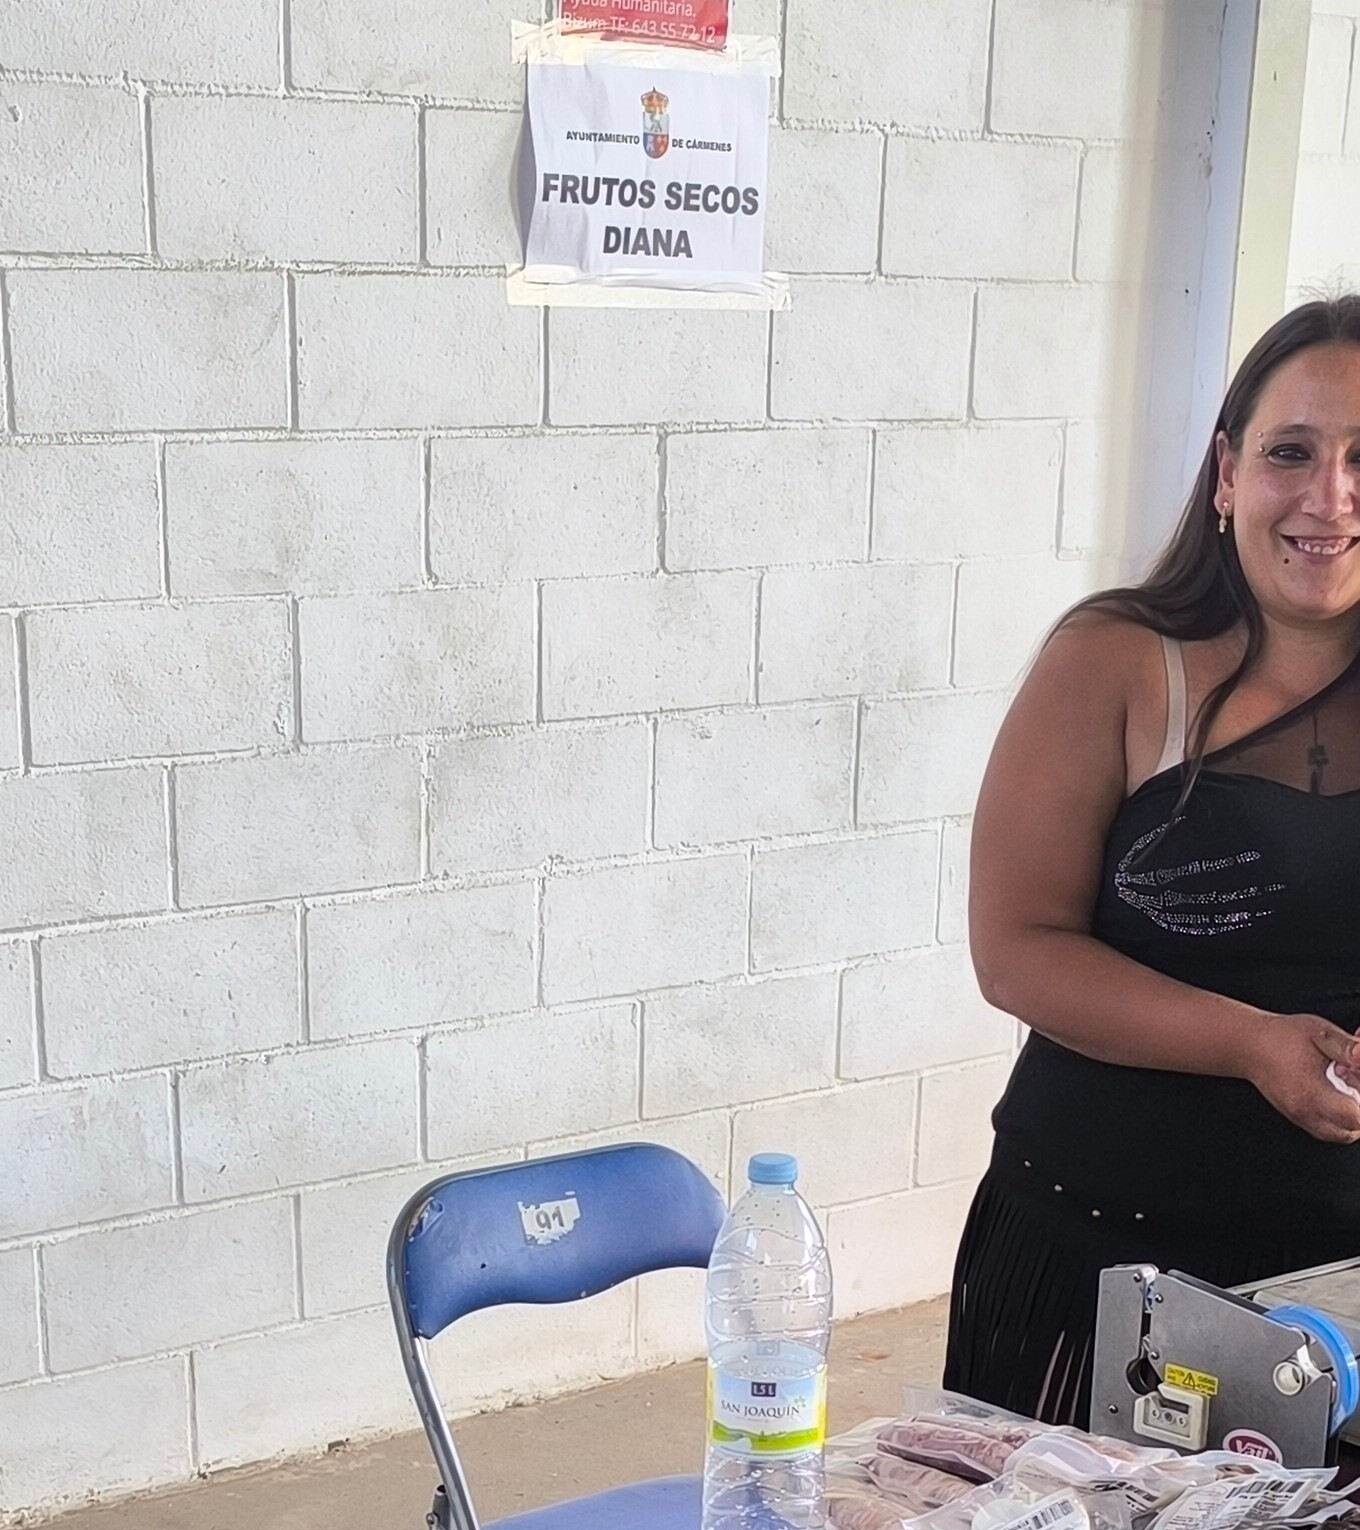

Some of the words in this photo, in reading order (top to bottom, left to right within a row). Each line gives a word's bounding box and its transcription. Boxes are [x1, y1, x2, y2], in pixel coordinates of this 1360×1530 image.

[661, 22, 676, 37] 55
[701, 26, 715, 43] 12
[566, 130, 640, 145] AYUNTAMIENTO
[672, 138, 684, 150] DE
[686, 138, 733, 152] CÁRMENES
[542, 172, 656, 209] FRUTOS
[664, 181, 759, 216] SECOS
[602, 225, 693, 259] DIANA
[721, 1400, 740, 1413] SAN
